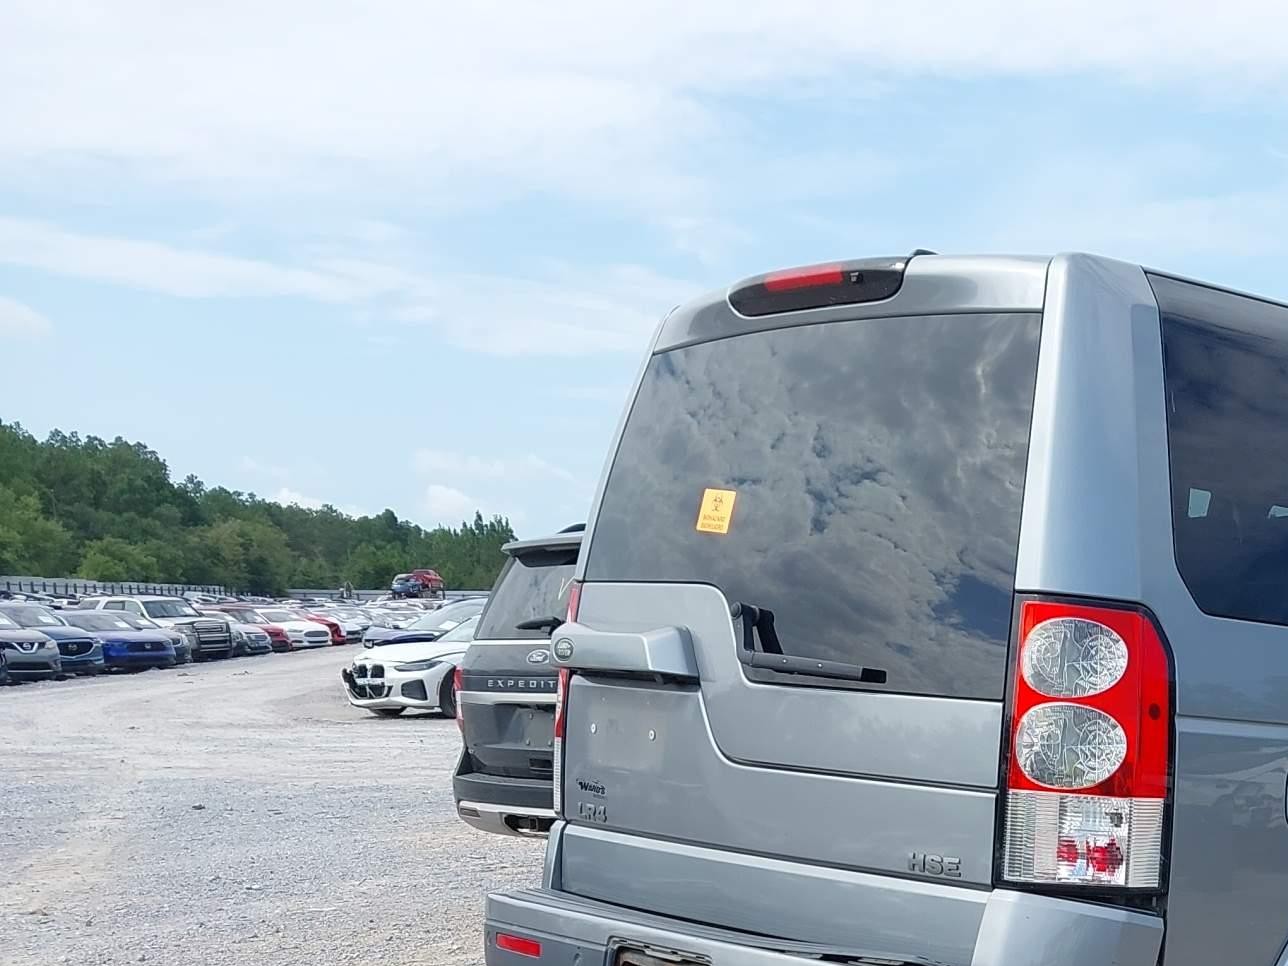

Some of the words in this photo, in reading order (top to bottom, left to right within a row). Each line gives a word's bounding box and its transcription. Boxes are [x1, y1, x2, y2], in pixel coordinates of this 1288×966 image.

[488, 680, 557, 688] EXPEDIT
[577, 801, 607, 823] LR4
[908, 852, 962, 877] HSE
